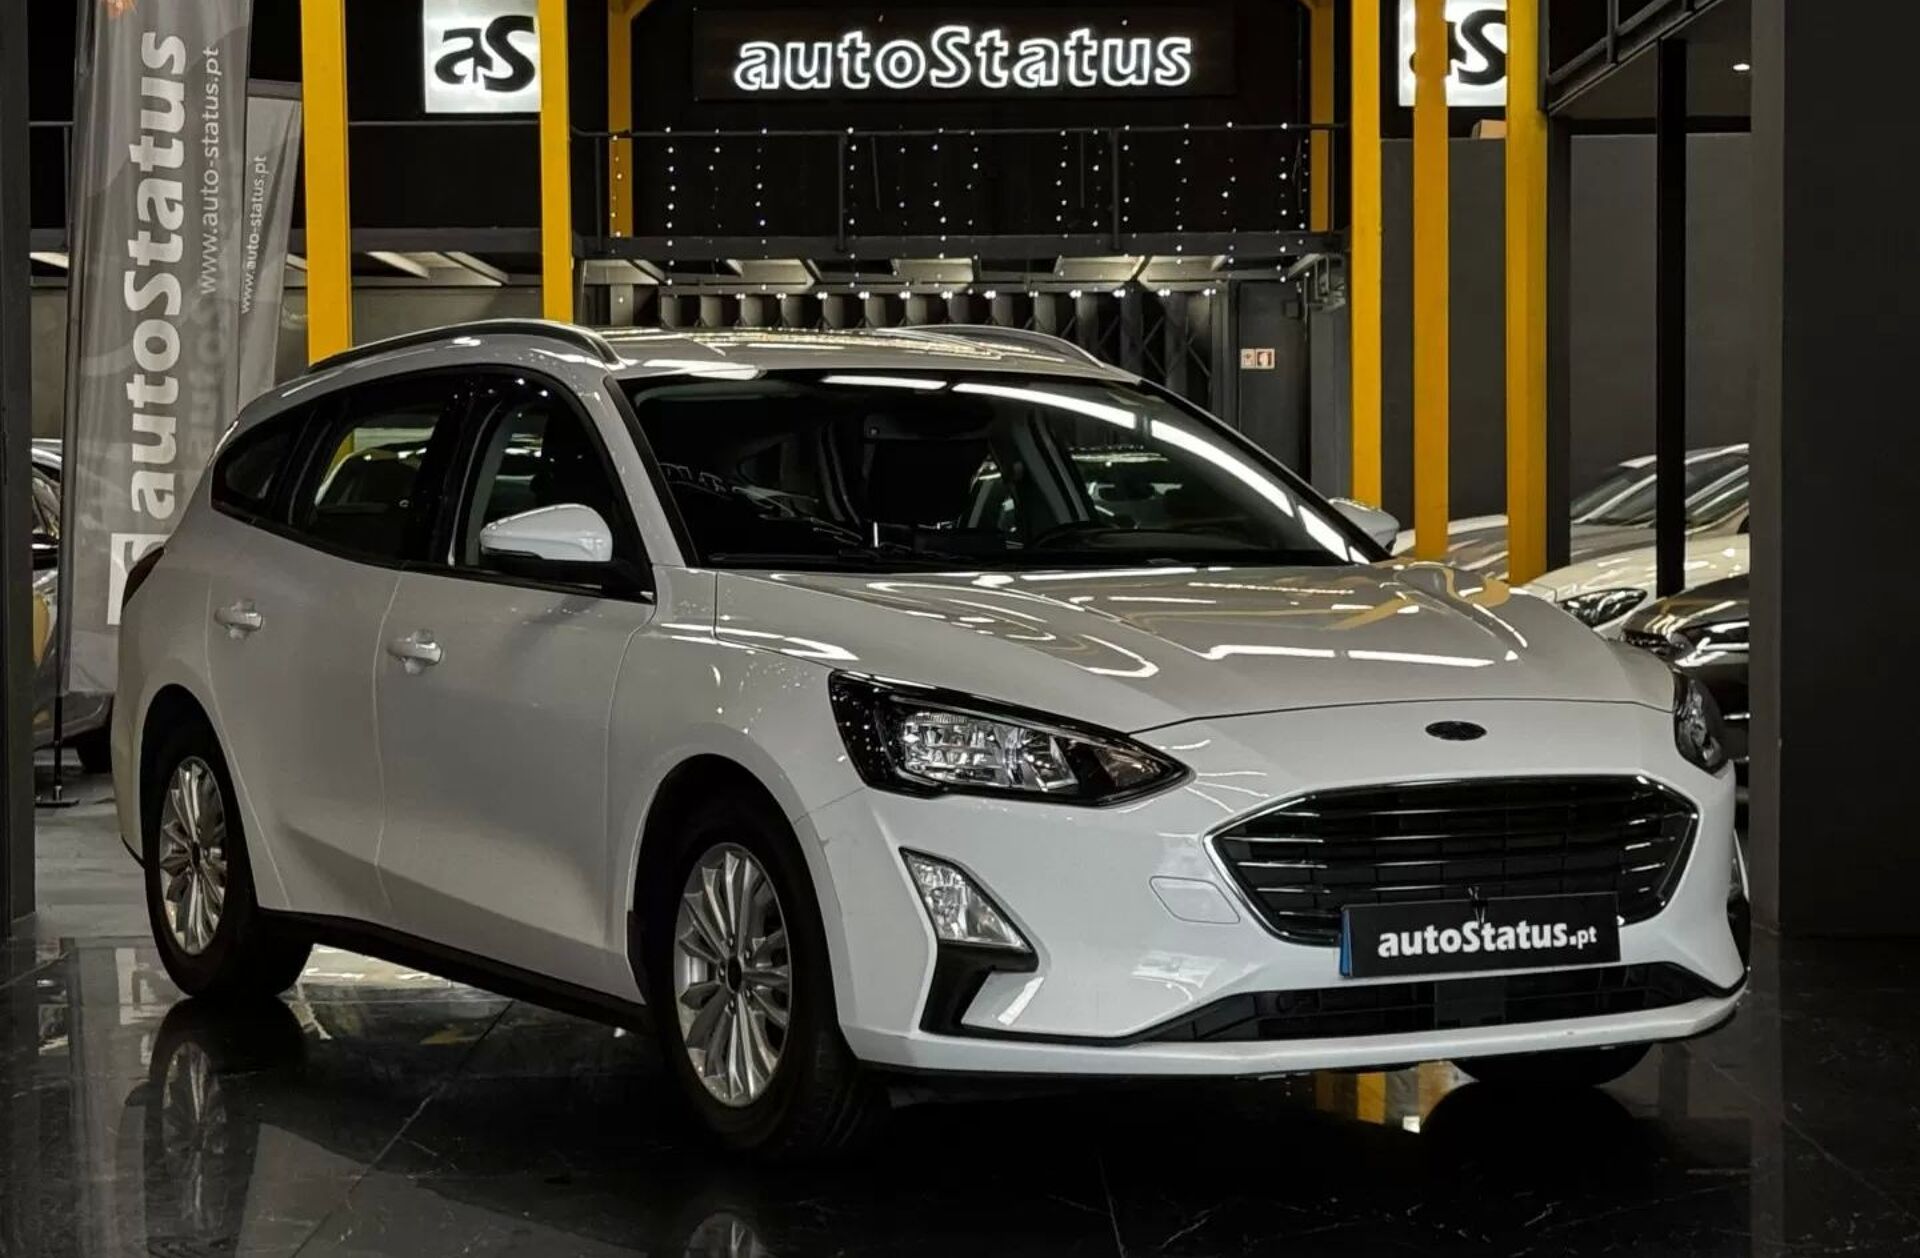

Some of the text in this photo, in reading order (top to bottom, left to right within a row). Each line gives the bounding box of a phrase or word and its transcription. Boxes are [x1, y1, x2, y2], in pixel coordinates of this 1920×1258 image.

[734, 25, 1191, 90] autoStatus
[200, 47, 222, 295] www.auto-status.pt
[241, 155, 270, 314] www.auto-status.pt
[124, 32, 186, 519] autoStatus
[1378, 920, 1597, 958] autoStatus.pt
